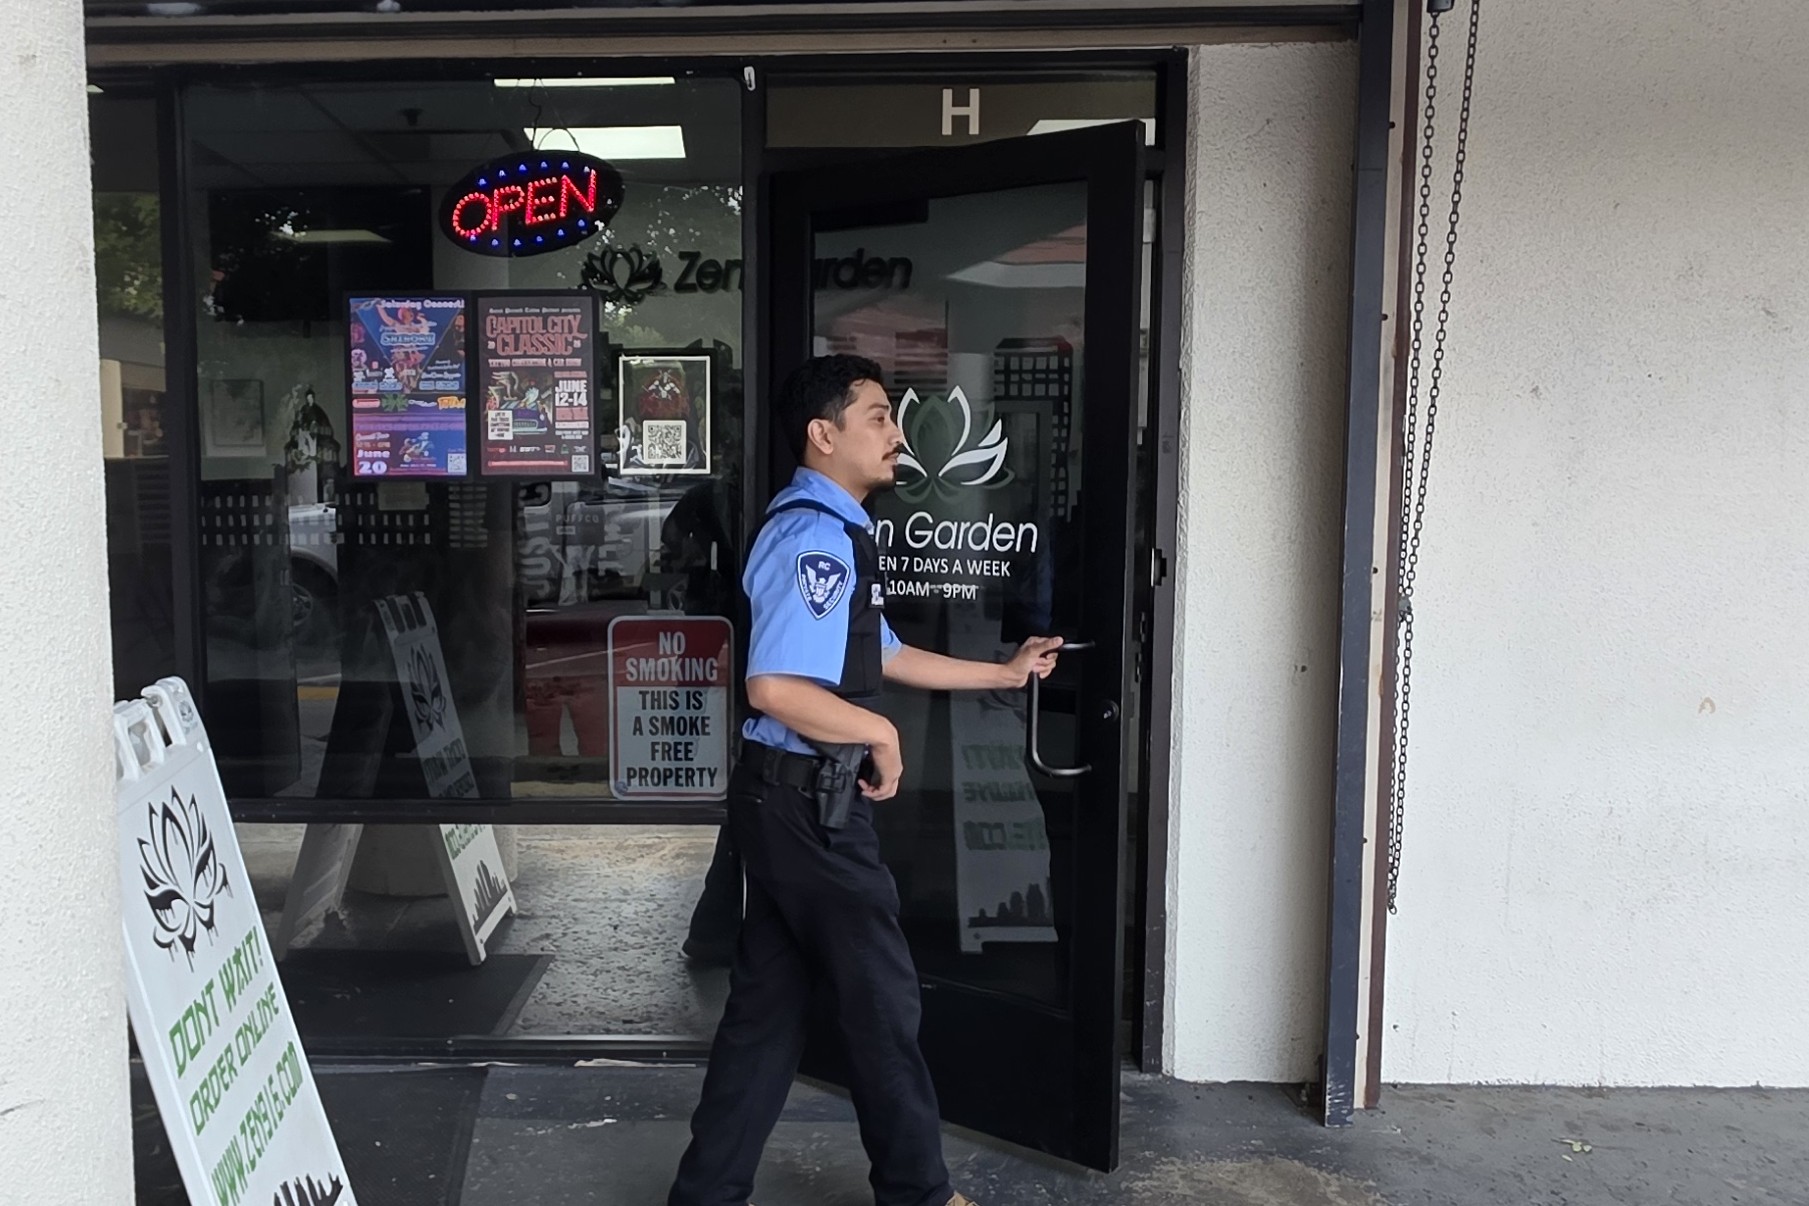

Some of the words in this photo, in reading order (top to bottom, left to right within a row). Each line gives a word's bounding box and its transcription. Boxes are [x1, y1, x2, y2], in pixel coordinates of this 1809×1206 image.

[942, 88, 979, 135] H
[453, 168, 596, 237] OPEN
[815, 248, 913, 290] rden
[486, 315, 547, 338] CAPITOL
[547, 314, 588, 339] CITY
[497, 333, 574, 356] CLASSIC
[555, 380, 588, 393] JUNE
[555, 392, 588, 407] 12-14
[357, 449, 390, 458] June
[358, 461, 388, 474] 20
[905, 511, 1038, 553] Garden
[818, 561, 831, 571] RC
[901, 556, 910, 572] 7
[913, 557, 949, 574] DAYS
[952, 559, 963, 574] A
[967, 560, 1011, 577] WEEK
[889, 579, 929, 597] 10AM
[943, 582, 977, 600] 9PM
[658, 631, 686, 655] NO
[625, 657, 719, 682] SMOKING
[638, 690, 680, 710] THIS
[685, 690, 703, 710] IS
[632, 716, 644, 736] A
[649, 716, 711, 736] SMOKE
[651, 741, 694, 761] FREE
[626, 767, 718, 787] PROPERTY
[168, 978, 220, 1080] DONT
[218, 925, 264, 1013] WAIT!
[189, 1043, 239, 1136] ORDER
[235, 981, 280, 1066] ONLINE
